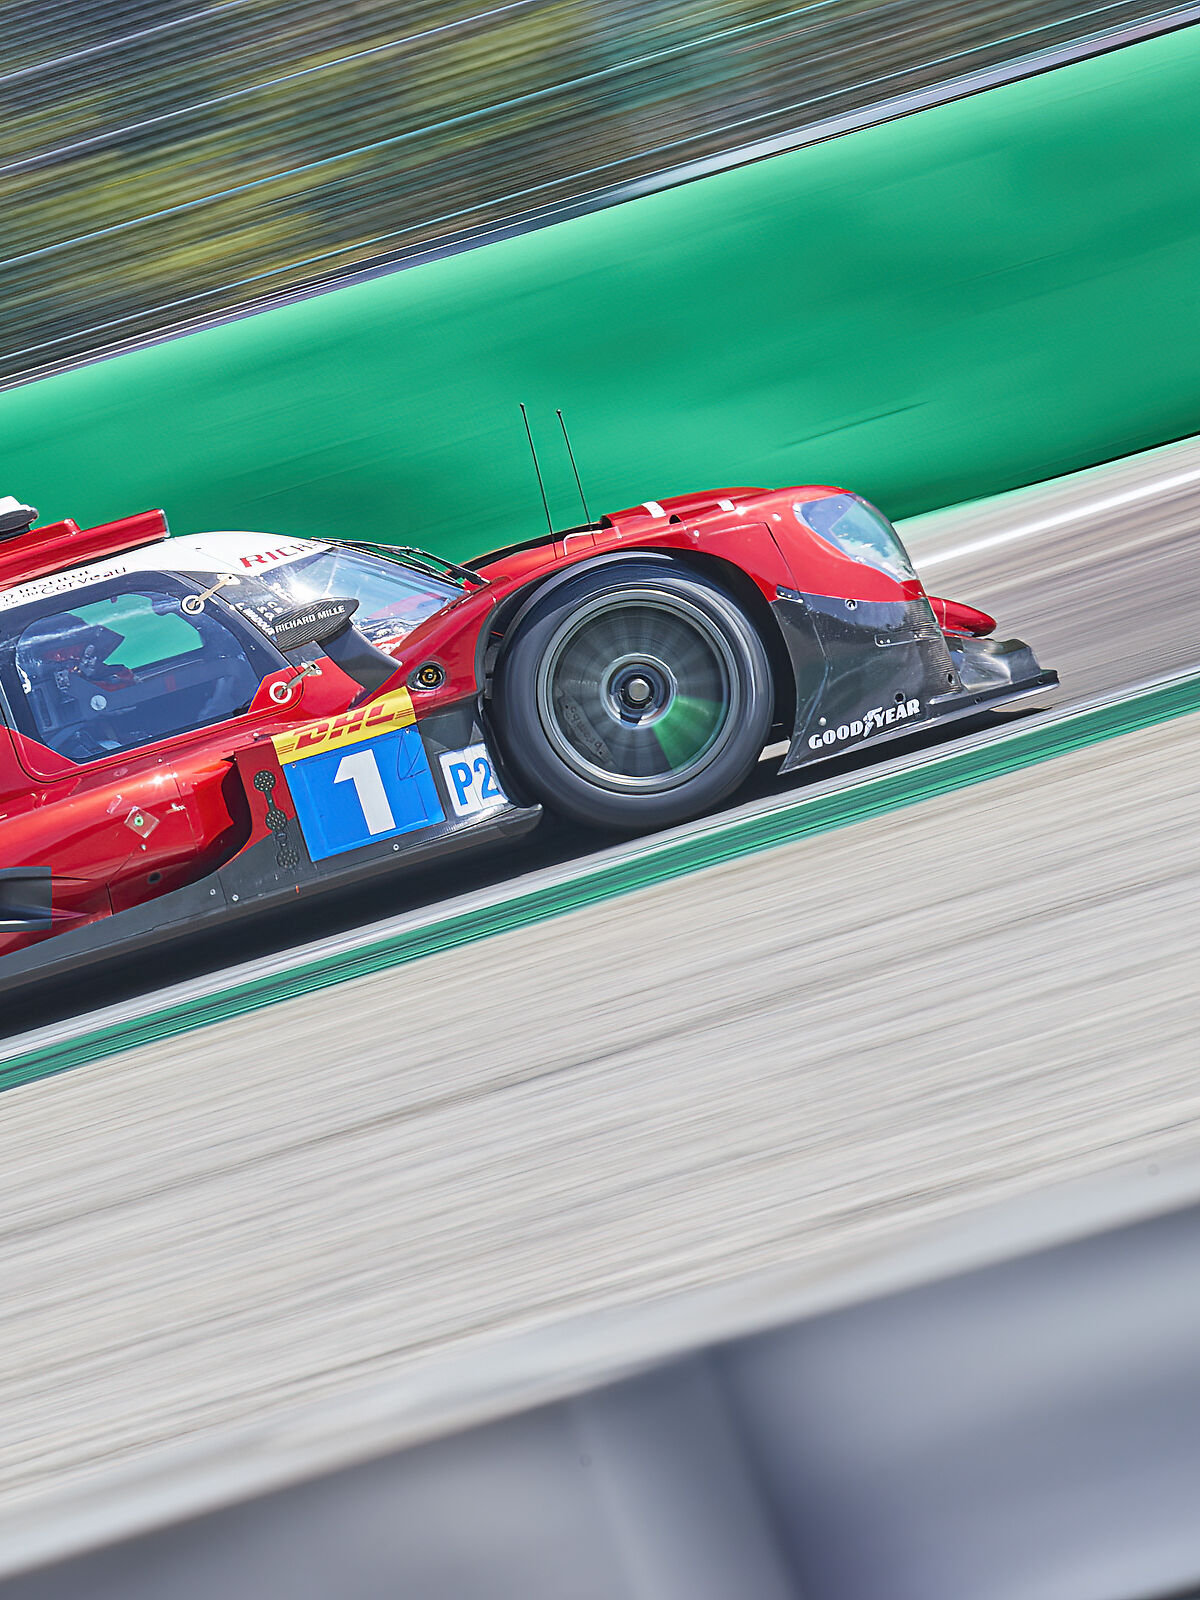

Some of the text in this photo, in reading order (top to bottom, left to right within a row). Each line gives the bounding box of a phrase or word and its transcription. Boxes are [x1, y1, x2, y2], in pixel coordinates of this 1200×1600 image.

[275, 605, 345, 634] RICHARD MILLE
[293, 703, 396, 751] DHL
[808, 698, 920, 750] GOODYEAR
[333, 748, 397, 836] 1
[449, 757, 500, 806] P2
